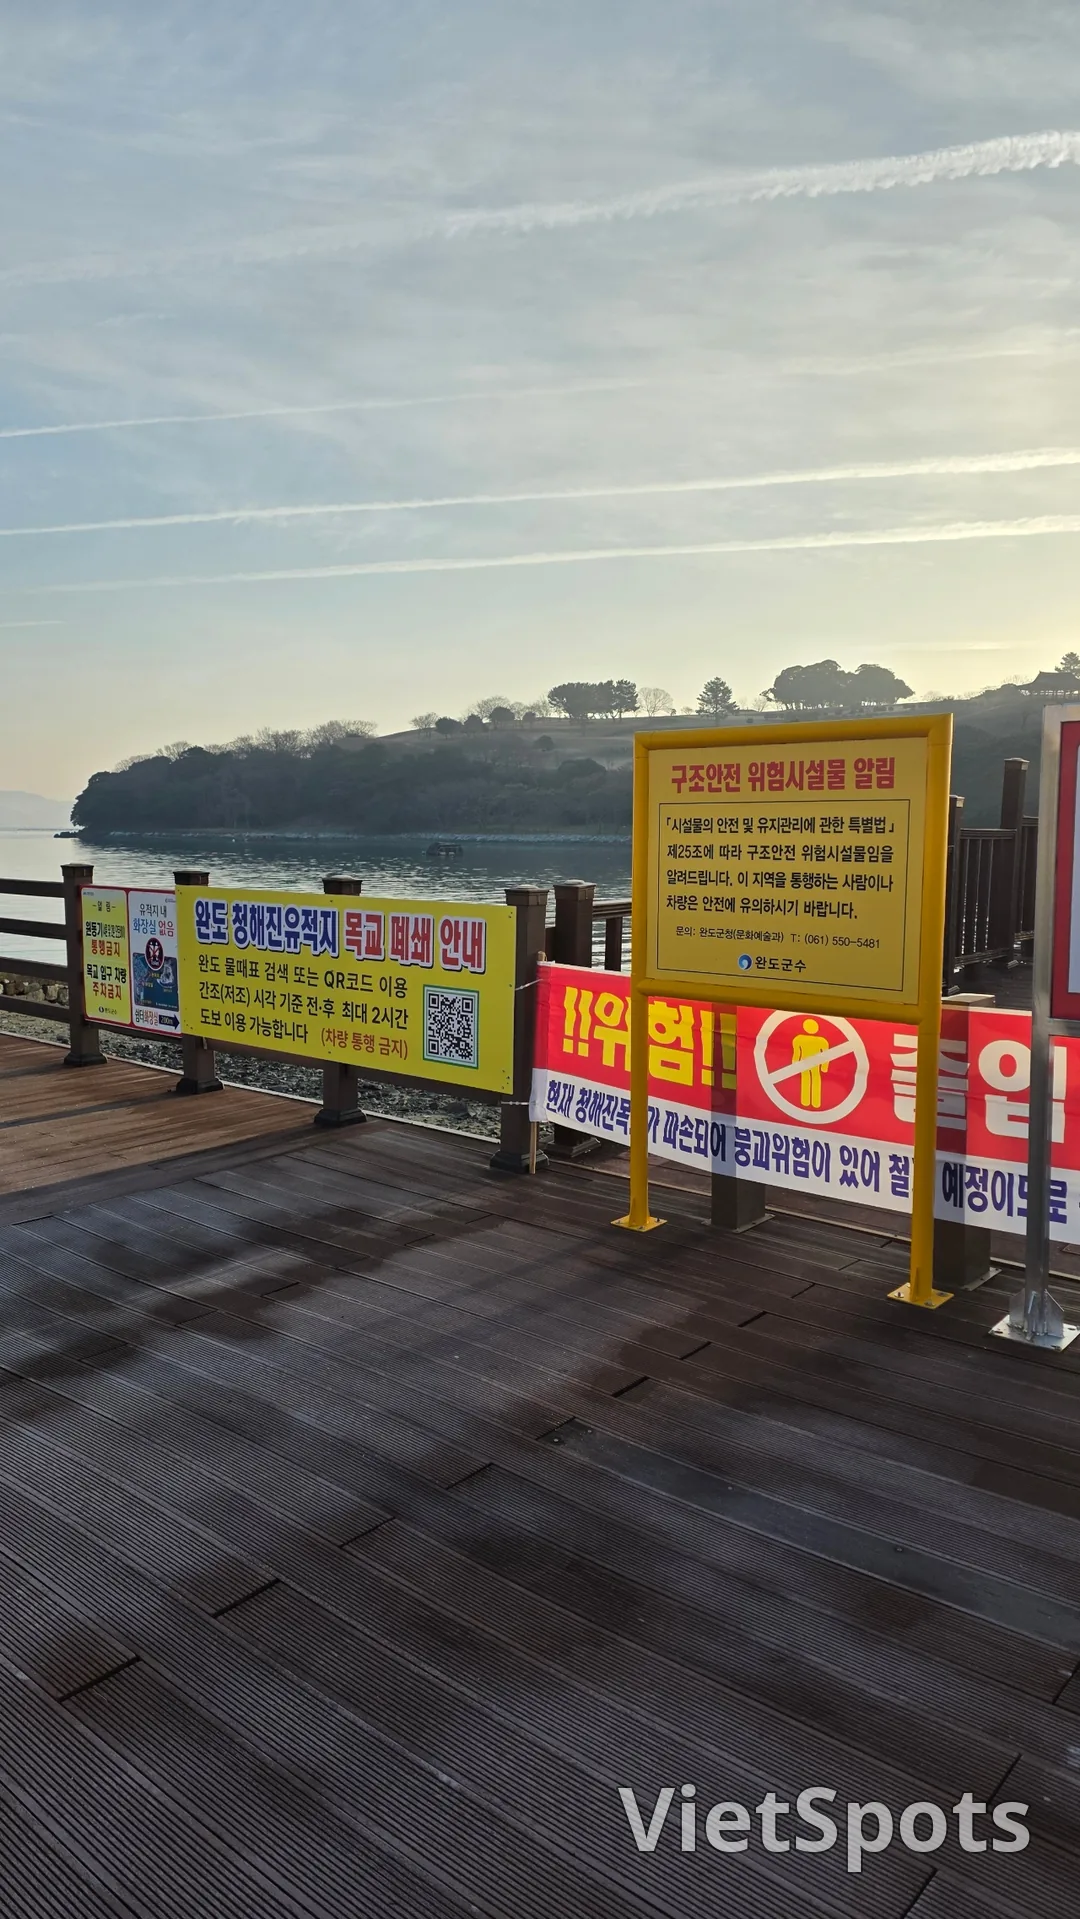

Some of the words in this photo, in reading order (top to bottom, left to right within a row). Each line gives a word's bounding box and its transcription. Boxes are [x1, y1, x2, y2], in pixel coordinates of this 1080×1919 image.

[672, 763, 741, 793] 구조안전
[748, 759, 846, 792] 위험시설물
[854, 757, 895, 789] 알림
[717, 817, 739, 834] 안전
[743, 817, 754, 834] 및
[757, 816, 816, 834] 유지관리에
[819, 816, 844, 833] 관한
[667, 844, 713, 859] 제25조에
[719, 844, 742, 860] 따라
[747, 844, 796, 861] 구조안전
[801, 845, 894, 863] 위험시설물임을
[666, 870, 733, 887] 알려드립니다.
[738, 871, 749, 887] 이
[753, 871, 786, 888] 지역을
[790, 873, 838, 890] 통행하는
[842, 874, 893, 892] 사람이나
[140, 903, 159, 918] 유적지
[160, 906, 167, 919] 내
[666, 895, 698, 911] 차량은
[703, 896, 736, 913] 안전에
[740, 898, 798, 916] 유의하시기
[804, 901, 858, 919] 바랍니다.
[133, 918, 156, 936] 화장실
[158, 920, 174, 937] 없음
[194, 899, 229, 943] 완도
[232, 902, 338, 954] 청해진유적지
[345, 911, 383, 957] 목교
[390, 915, 432, 964] 폐쇄
[439, 918, 484, 969] 안내
[676, 926, 695, 937] 문의:
[699, 927, 784, 943] 완도군청(문화예술과)
[791, 933, 800, 943] T:
[804, 934, 829, 946] (061)
[832, 936, 880, 949] 550-5481
[91, 939, 120, 957] 통행금지
[86, 963, 98, 980] 목교
[115, 967, 127, 984] 차량
[755, 956, 806, 972] 완도군수
[198, 954, 221, 973] 완도
[224, 957, 260, 979] 물때표
[264, 962, 289, 984] 검색
[293, 966, 319, 988] 또는
[324, 970, 373, 993] QR코드
[379, 975, 408, 999] 이용
[92, 982, 122, 1000] 주차금지
[199, 981, 250, 1007] 간조(저조)
[254, 988, 276, 1010] 시각
[280, 992, 303, 1014] 기준
[342, 1001, 367, 1024] 최대
[372, 1006, 408, 1030] 2시간
[200, 1008, 222, 1027] 도보
[224, 1012, 246, 1032] 이용
[250, 1016, 308, 1043] 가능합니다
[321, 1028, 348, 1049] (차량
[352, 1032, 375, 1053] 통행
[379, 1036, 408, 1060] 금지)
[546, 1079, 574, 1118] 현재
[576, 1087, 660, 1144] 청해진목가
[663, 1111, 726, 1161] 파손되어
[734, 1126, 831, 1183] 붕괴위험이
[839, 1145, 880, 1192] 있어
[889, 1154, 915, 1198] 철
